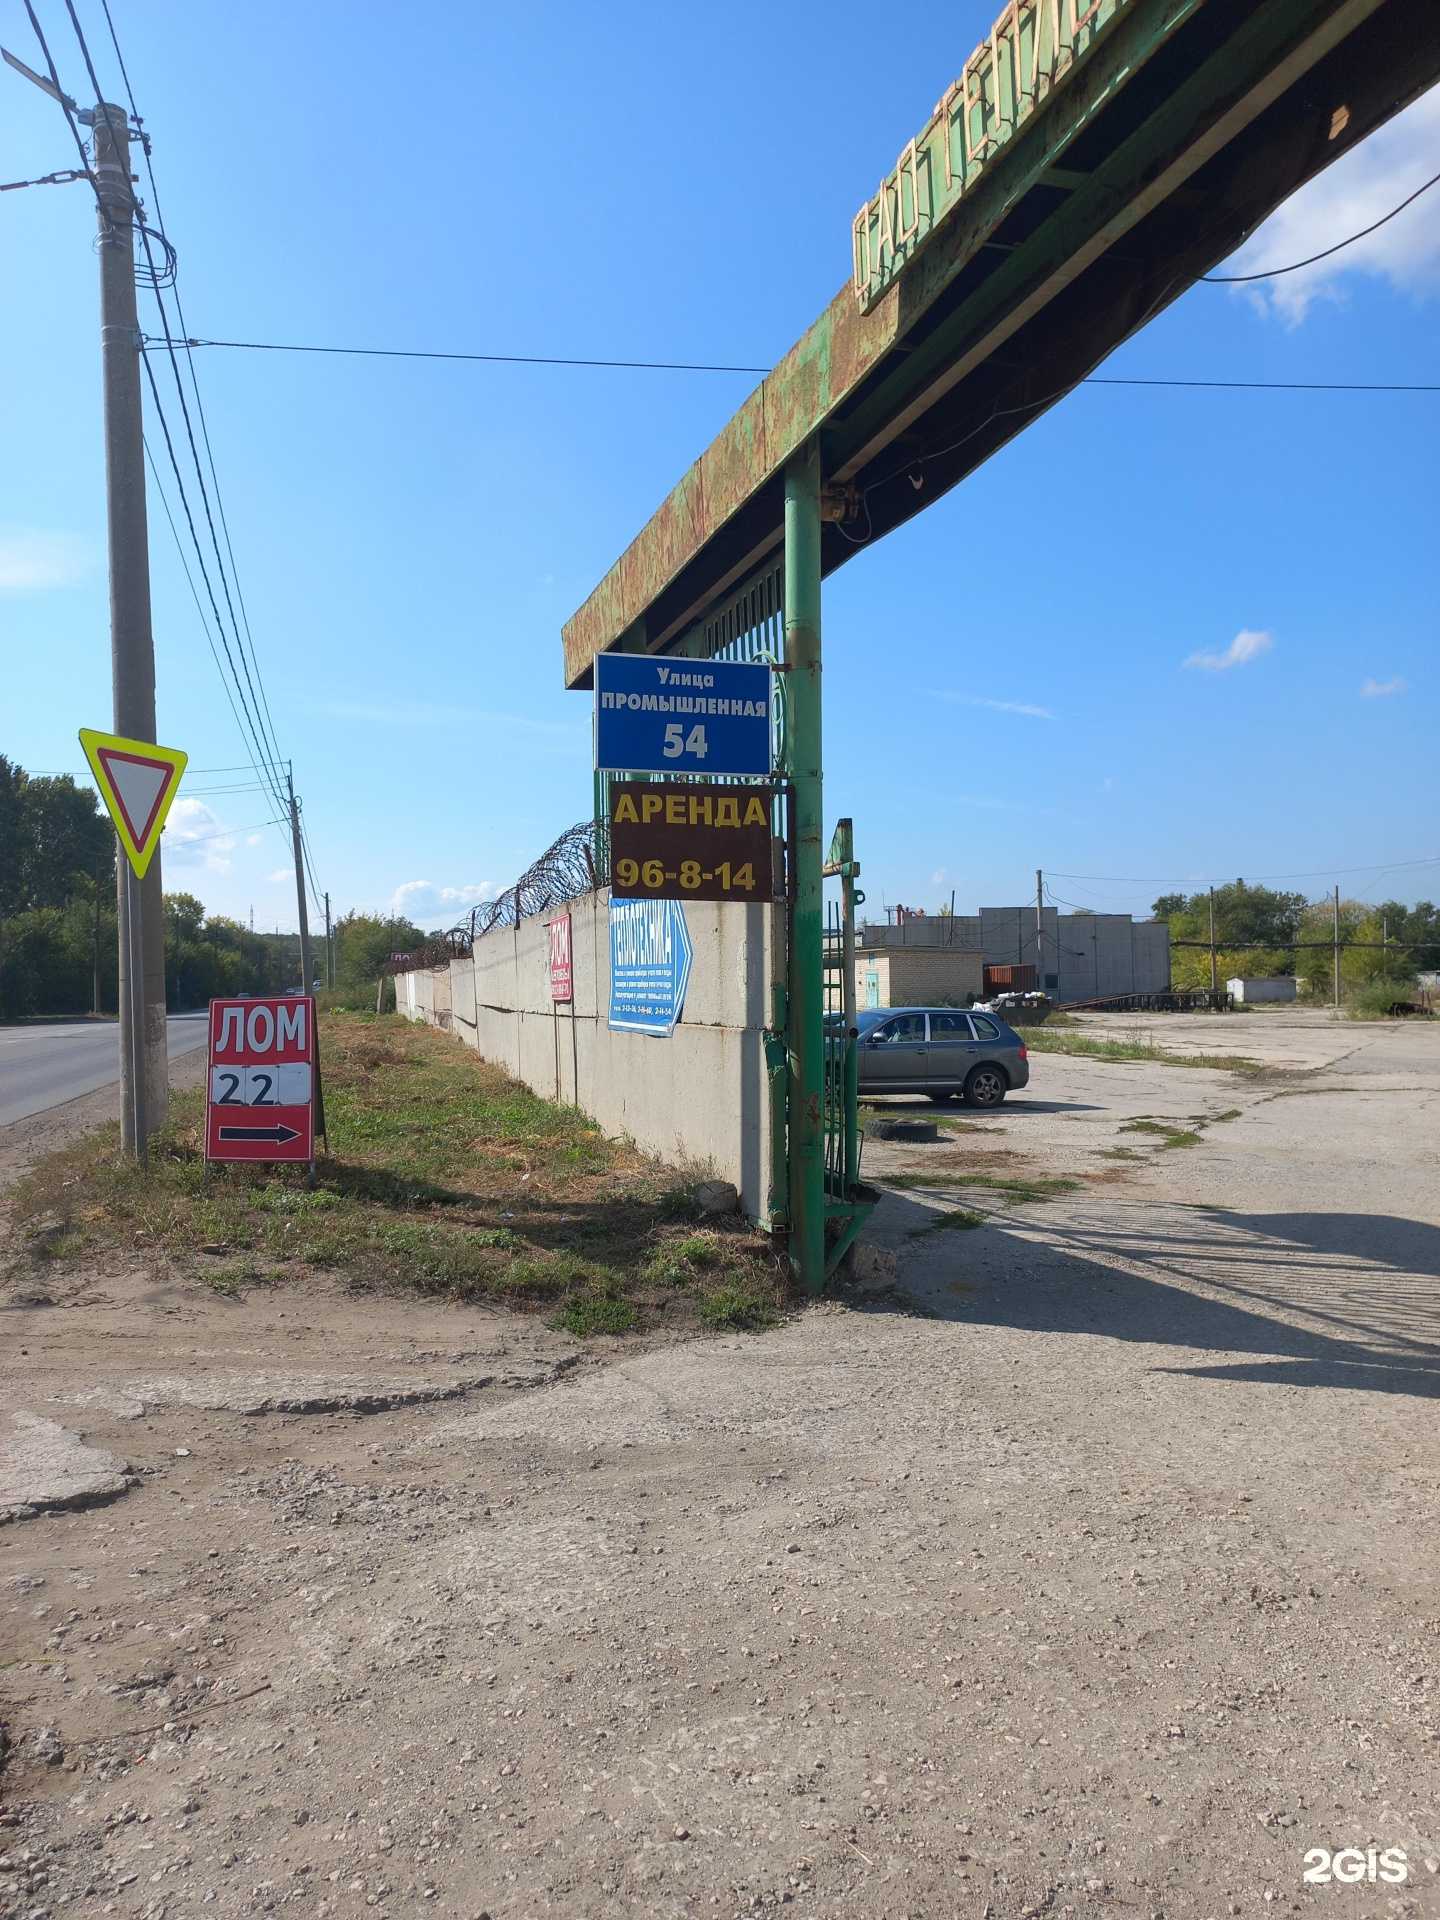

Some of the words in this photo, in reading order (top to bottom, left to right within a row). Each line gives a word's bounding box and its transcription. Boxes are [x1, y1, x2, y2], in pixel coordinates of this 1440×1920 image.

[852, 136, 919, 299] ОАО
[656, 667, 714, 689] Улица
[601, 692, 767, 717] ПРОМЫШЛЕННАЯ
[663, 723, 708, 759] 54
[614, 793, 768, 828] АРЕНДА
[616, 858, 756, 891] 96-8-14
[215, 1004, 305, 1053] ЛОМ
